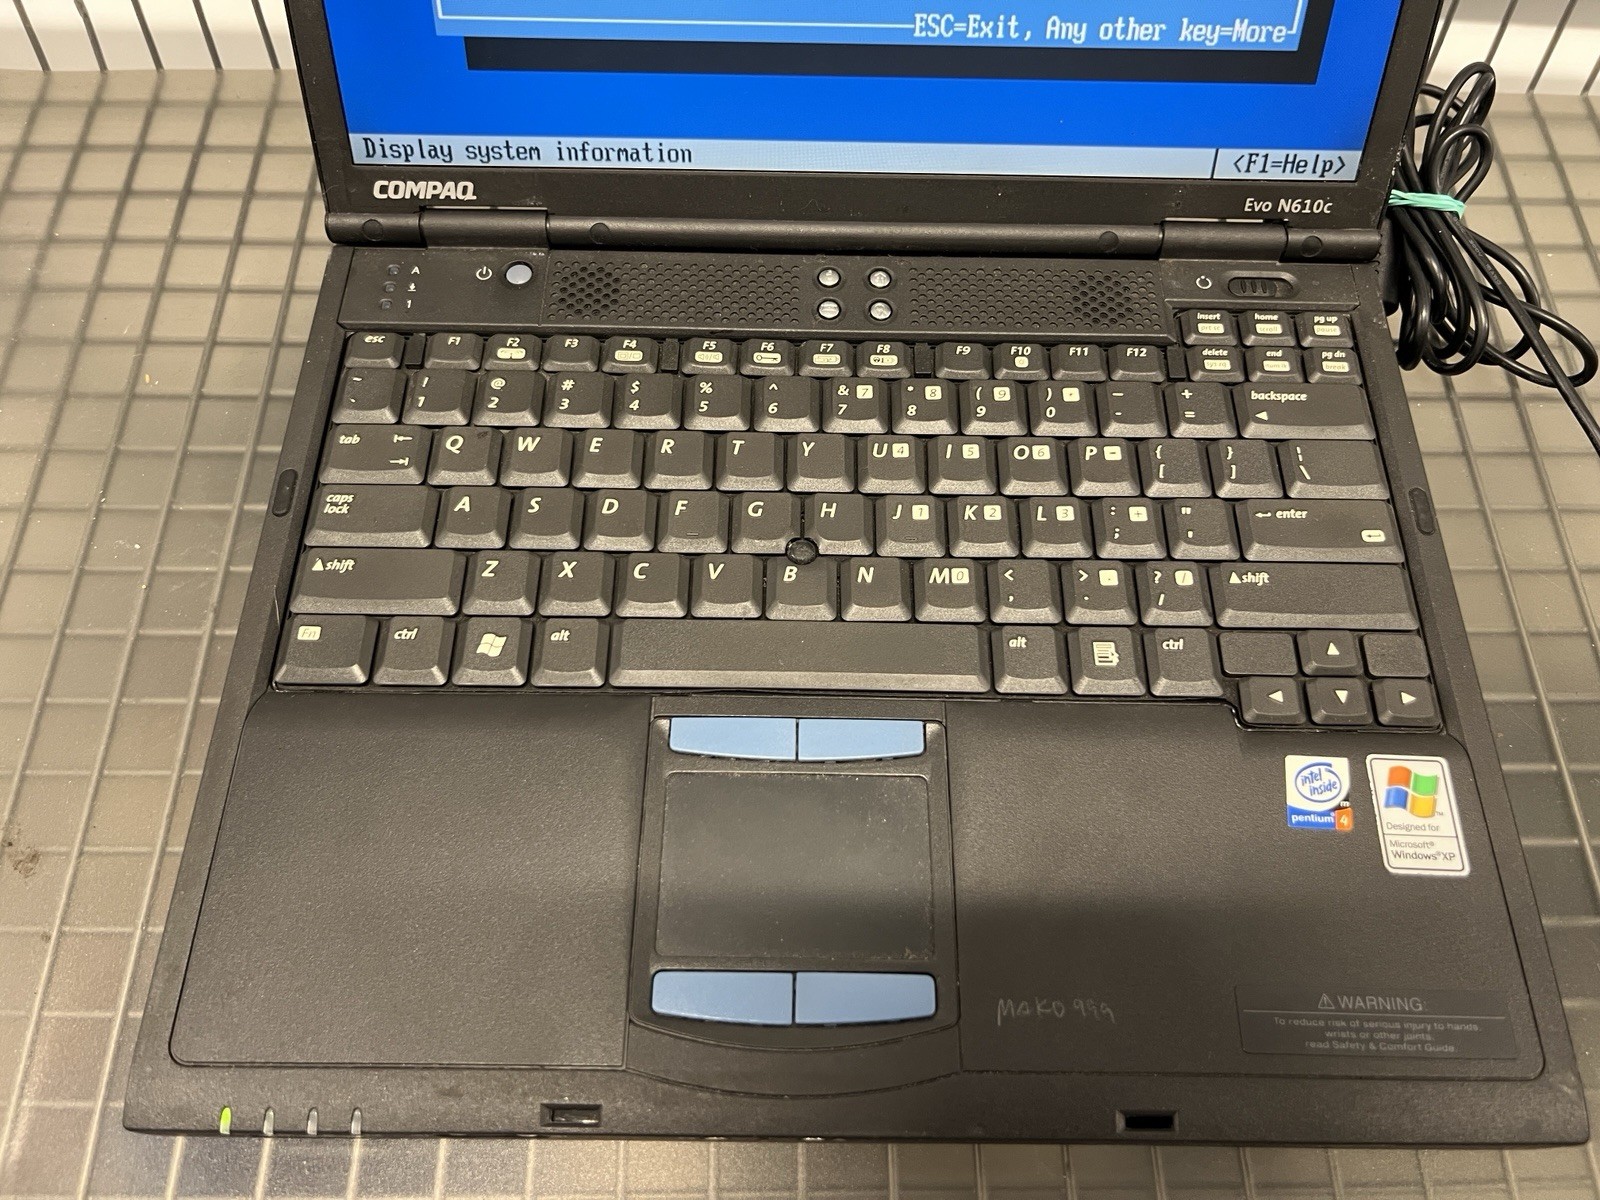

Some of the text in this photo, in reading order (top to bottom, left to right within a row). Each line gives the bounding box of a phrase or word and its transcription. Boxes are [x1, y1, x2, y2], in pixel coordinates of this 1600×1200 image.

[913, 13, 1286, 46] ESC=Exit, Any other key=More
[363, 137, 693, 164] Display system information
[1233, 152, 1347, 177] <F1=Help>
[372, 179, 478, 201] COMPAQ
[1244, 197, 1333, 214] Evo N610c
[410, 265, 420, 275] A
[1196, 312, 1221, 321] insert
[1254, 312, 1279, 321] home
[1313, 315, 1339, 324] pg up
[364, 335, 386, 344] esc
[447, 336, 462, 346] F1
[506, 337, 521, 347] F2
[564, 338, 579, 348] F3
[622, 339, 637, 349] F4
[702, 340, 717, 351] F5
[760, 341, 775, 352] F6
[819, 342, 835, 353] F7
[876, 344, 891, 354] F8
[955, 345, 972, 356] F9
[1010, 345, 1032, 356] F10
[1069, 346, 1089, 357] F11
[1126, 347, 1148, 357] F12
[1201, 348, 1229, 357] delete
[1265, 349, 1283, 357] end
[1321, 349, 1346, 360] pg dn
[421, 376, 430, 388] !
[490, 377, 506, 390] @
[560, 379, 576, 391] #
[630, 380, 641, 395] $
[699, 381, 713, 394] %
[837, 384, 850, 396] &
[1180, 389, 1193, 400] +
[1250, 390, 1308, 403] backspace
[417, 396, 426, 408] 1
[487, 396, 500, 409] 2
[558, 398, 570, 410] 3
[628, 399, 640, 411] 4
[698, 400, 710, 413] 5
[768, 402, 779, 414] 6
[837, 403, 848, 416] 7
[906, 404, 918, 417] 8
[976, 405, 987, 418] 9
[1045, 406, 1056, 418] 0
[338, 434, 361, 445] tab
[445, 435, 464, 455] Q
[517, 436, 541, 452] W
[589, 437, 604, 453] E
[660, 438, 675, 455] R
[732, 439, 746, 456] T
[802, 441, 816, 457] Y
[872, 442, 889, 458] U
[945, 443, 953, 459] I
[1013, 444, 1030, 461] O
[1085, 445, 1098, 461] P
[326, 494, 354, 504] caps
[453, 495, 471, 513] A
[527, 497, 542, 514] S
[324, 503, 349, 514] lock
[601, 498, 619, 515] D
[674, 500, 689, 516] F
[747, 501, 765, 518] G
[820, 502, 837, 519] H
[892, 504, 903, 520] J
[963, 504, 979, 521] K
[1036, 505, 1048, 522] L
[1275, 508, 1308, 519] enter
[325, 558, 355, 573] shift
[481, 560, 499, 578] Z
[557, 561, 578, 579] X
[633, 562, 650, 580] C
[708, 562, 725, 580] V
[782, 565, 798, 582] B
[857, 566, 875, 584] N
[928, 567, 950, 585] M
[1241, 571, 1270, 587] shift
[393, 627, 419, 640] ctrl
[550, 629, 571, 642] alt
[1008, 635, 1028, 649] alt
[1162, 638, 1184, 651] ctrl
[1300, 767, 1322, 786] intel
[1309, 779, 1338, 796] inside
[1340, 814, 1349, 826] 4
[1385, 822, 1440, 832] Designed for
[1273, 1016, 1286, 1026] To
[1288, 1017, 1325, 1027] reduce
[1327, 1018, 1347, 1028] risk
[1349, 1019, 1361, 1028] of
[1362, 1019, 1401, 1029] serious
[1403, 1020, 1432, 1031] injury
[1433, 1021, 1445, 1030] to
[1324, 1030, 1357, 1039] wrists
[1359, 1031, 1371, 1040] or
[1373, 1030, 1401, 1040] other
[1305, 1040, 1330, 1049] read
[1331, 1040, 1366, 1051] Safety
[1368, 1042, 1377, 1051] &
[1378, 1041, 1422, 1052] Comfort
